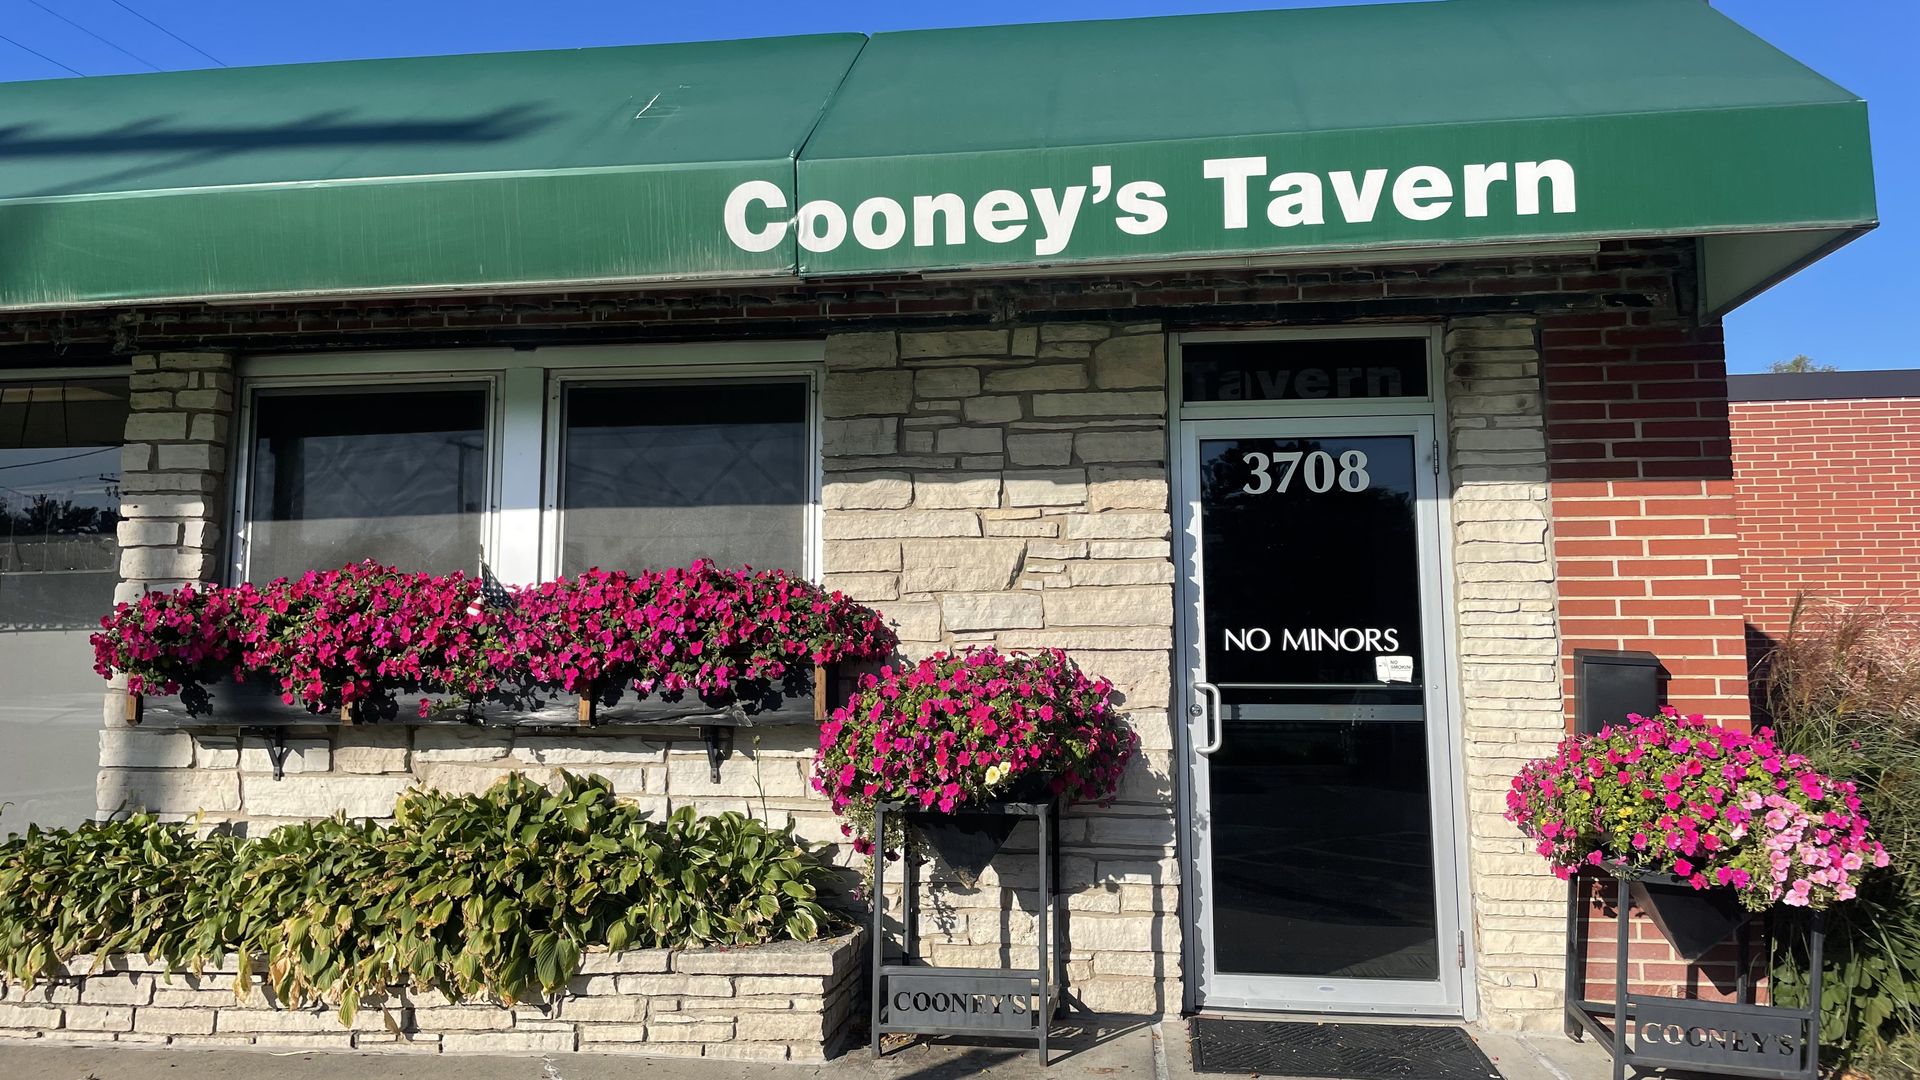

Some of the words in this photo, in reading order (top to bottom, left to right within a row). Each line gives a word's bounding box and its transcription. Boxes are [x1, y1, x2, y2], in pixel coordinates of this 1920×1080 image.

[724, 165, 1168, 256] Cooney's
[1204, 157, 1576, 229] Tavern
[1185, 361, 1403, 399] Tavern
[1242, 450, 1370, 494] 3708
[1224, 627, 1271, 652] NO
[1282, 627, 1399, 652] MINORS
[893, 991, 1027, 1015] COONEY'S
[1640, 1022, 1794, 1056] COONEY'S
